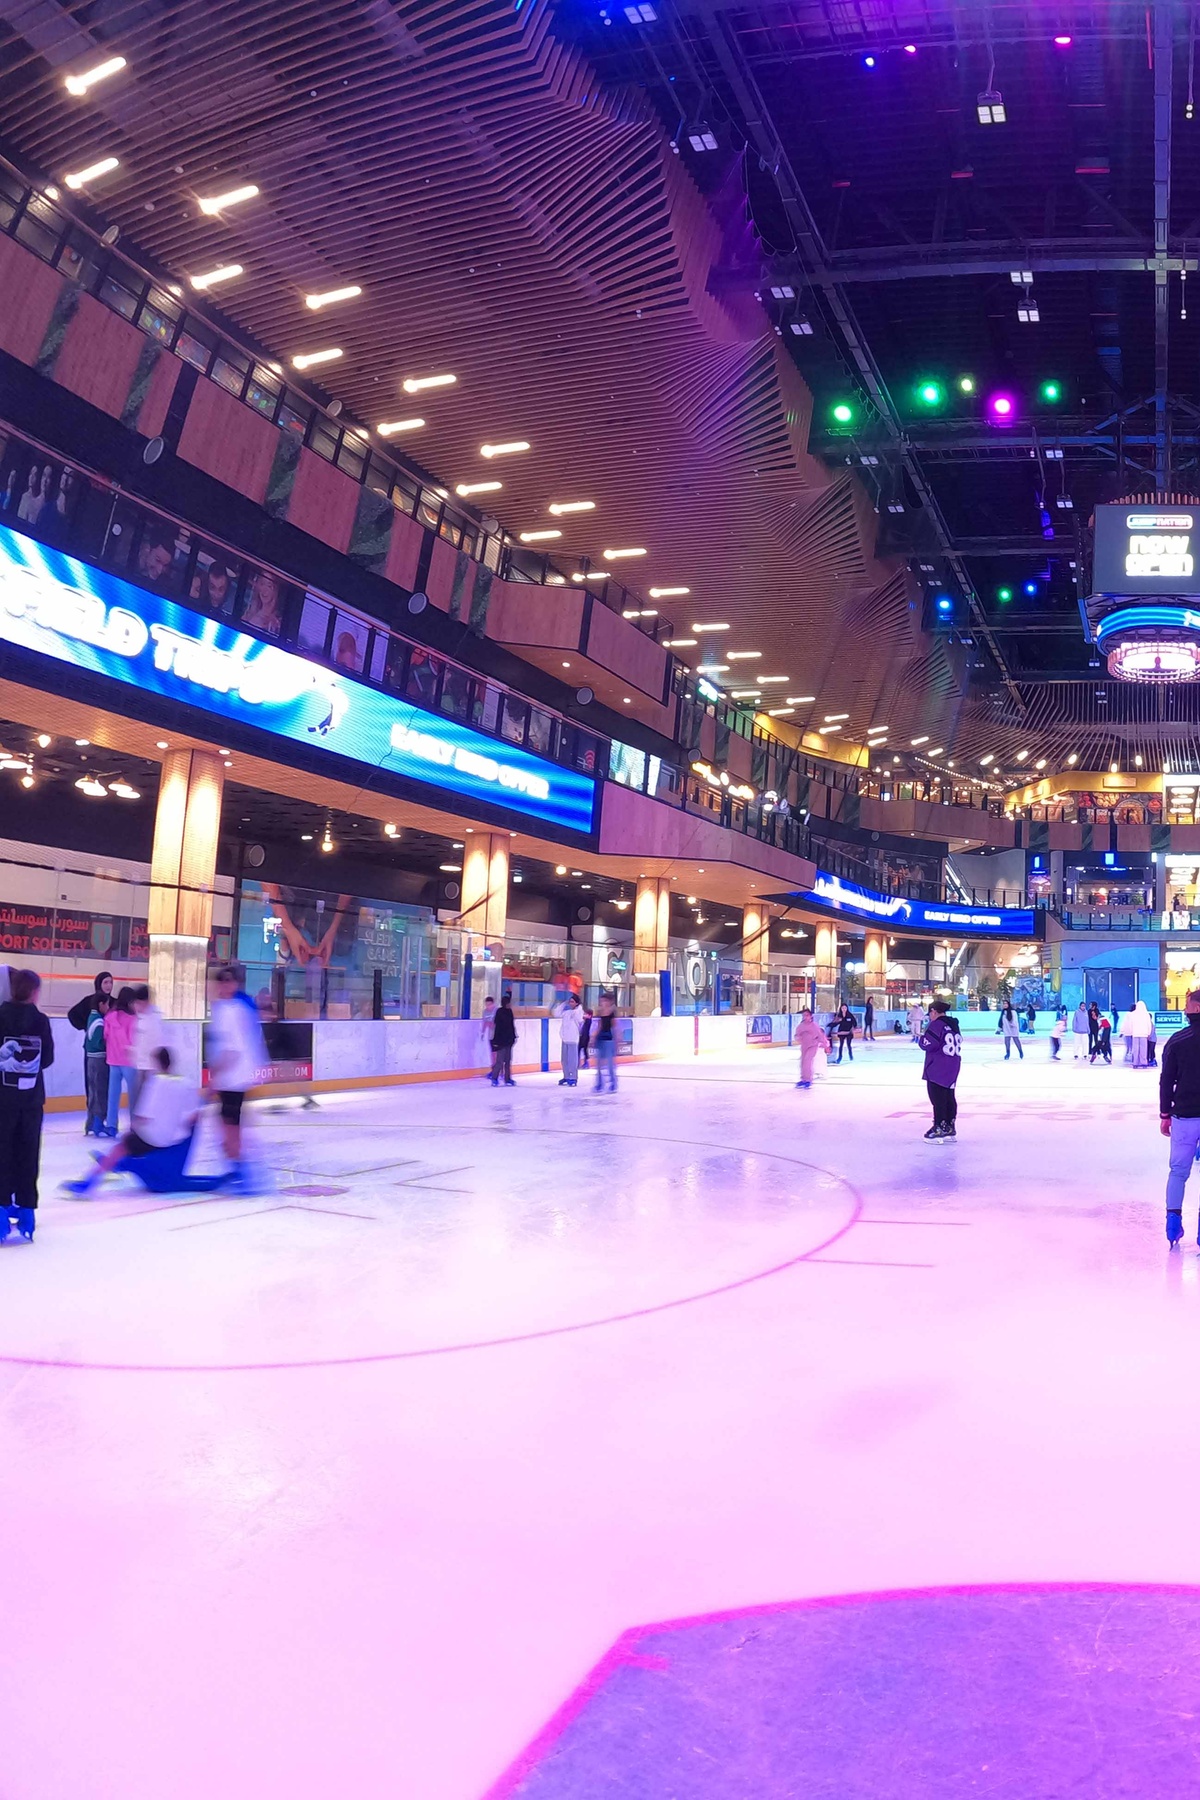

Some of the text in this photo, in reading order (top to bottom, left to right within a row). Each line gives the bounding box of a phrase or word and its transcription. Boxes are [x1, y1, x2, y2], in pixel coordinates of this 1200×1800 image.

[0, 908, 47, 929] سوسايت
[924, 910, 949, 922] EARLY
[971, 914, 1001, 925] OFFER
[0, 933, 87, 953] ORT SOCIETY
[130, 945, 149, 959] SPO
[943, 1033, 963, 1056] 88
